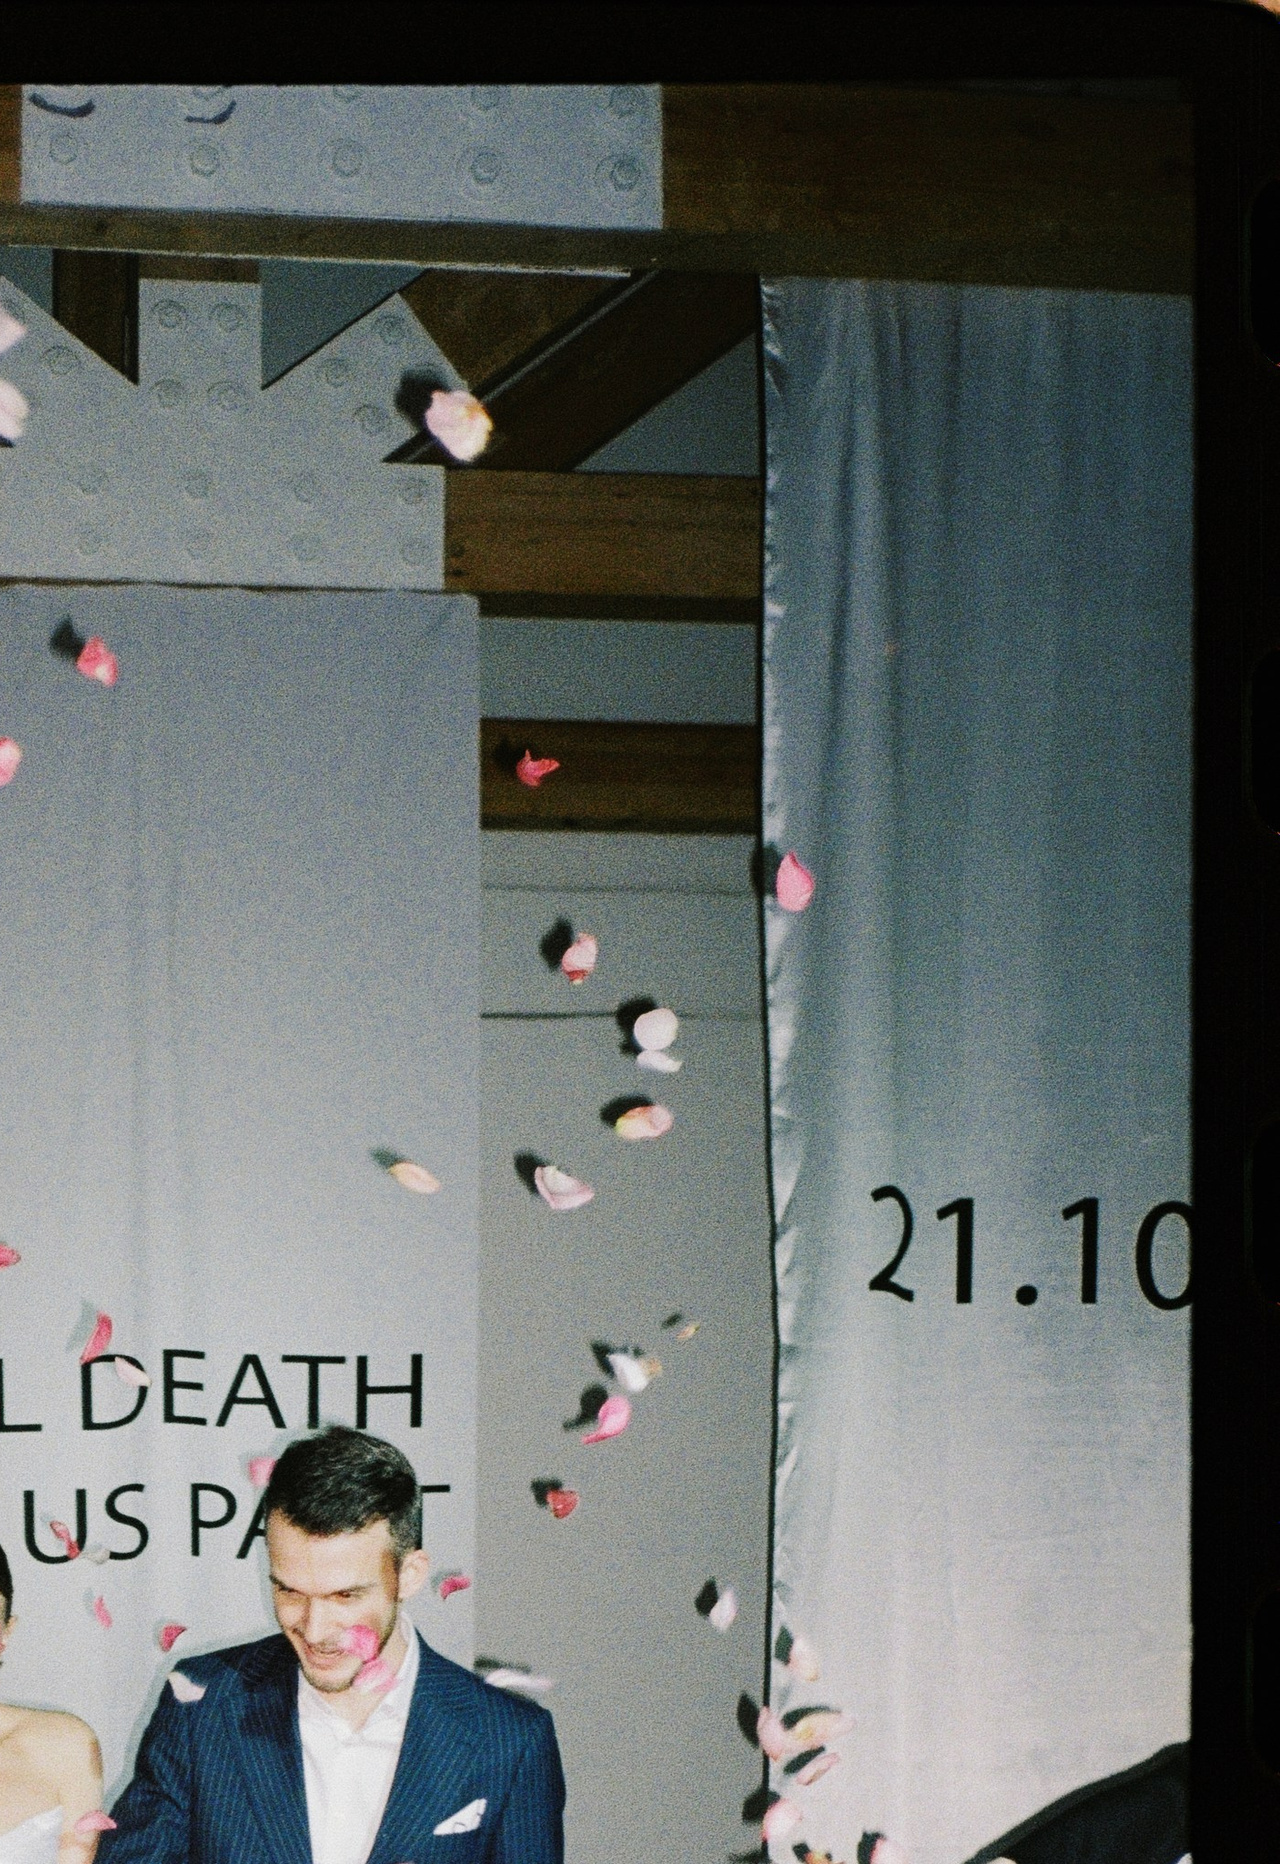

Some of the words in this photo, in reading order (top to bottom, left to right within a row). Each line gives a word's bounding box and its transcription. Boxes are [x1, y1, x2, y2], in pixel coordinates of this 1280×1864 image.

[869, 1185, 1193, 1310] 21.10
[80, 1348, 423, 1430] DEATH
[23, 1483, 149, 1565] US
